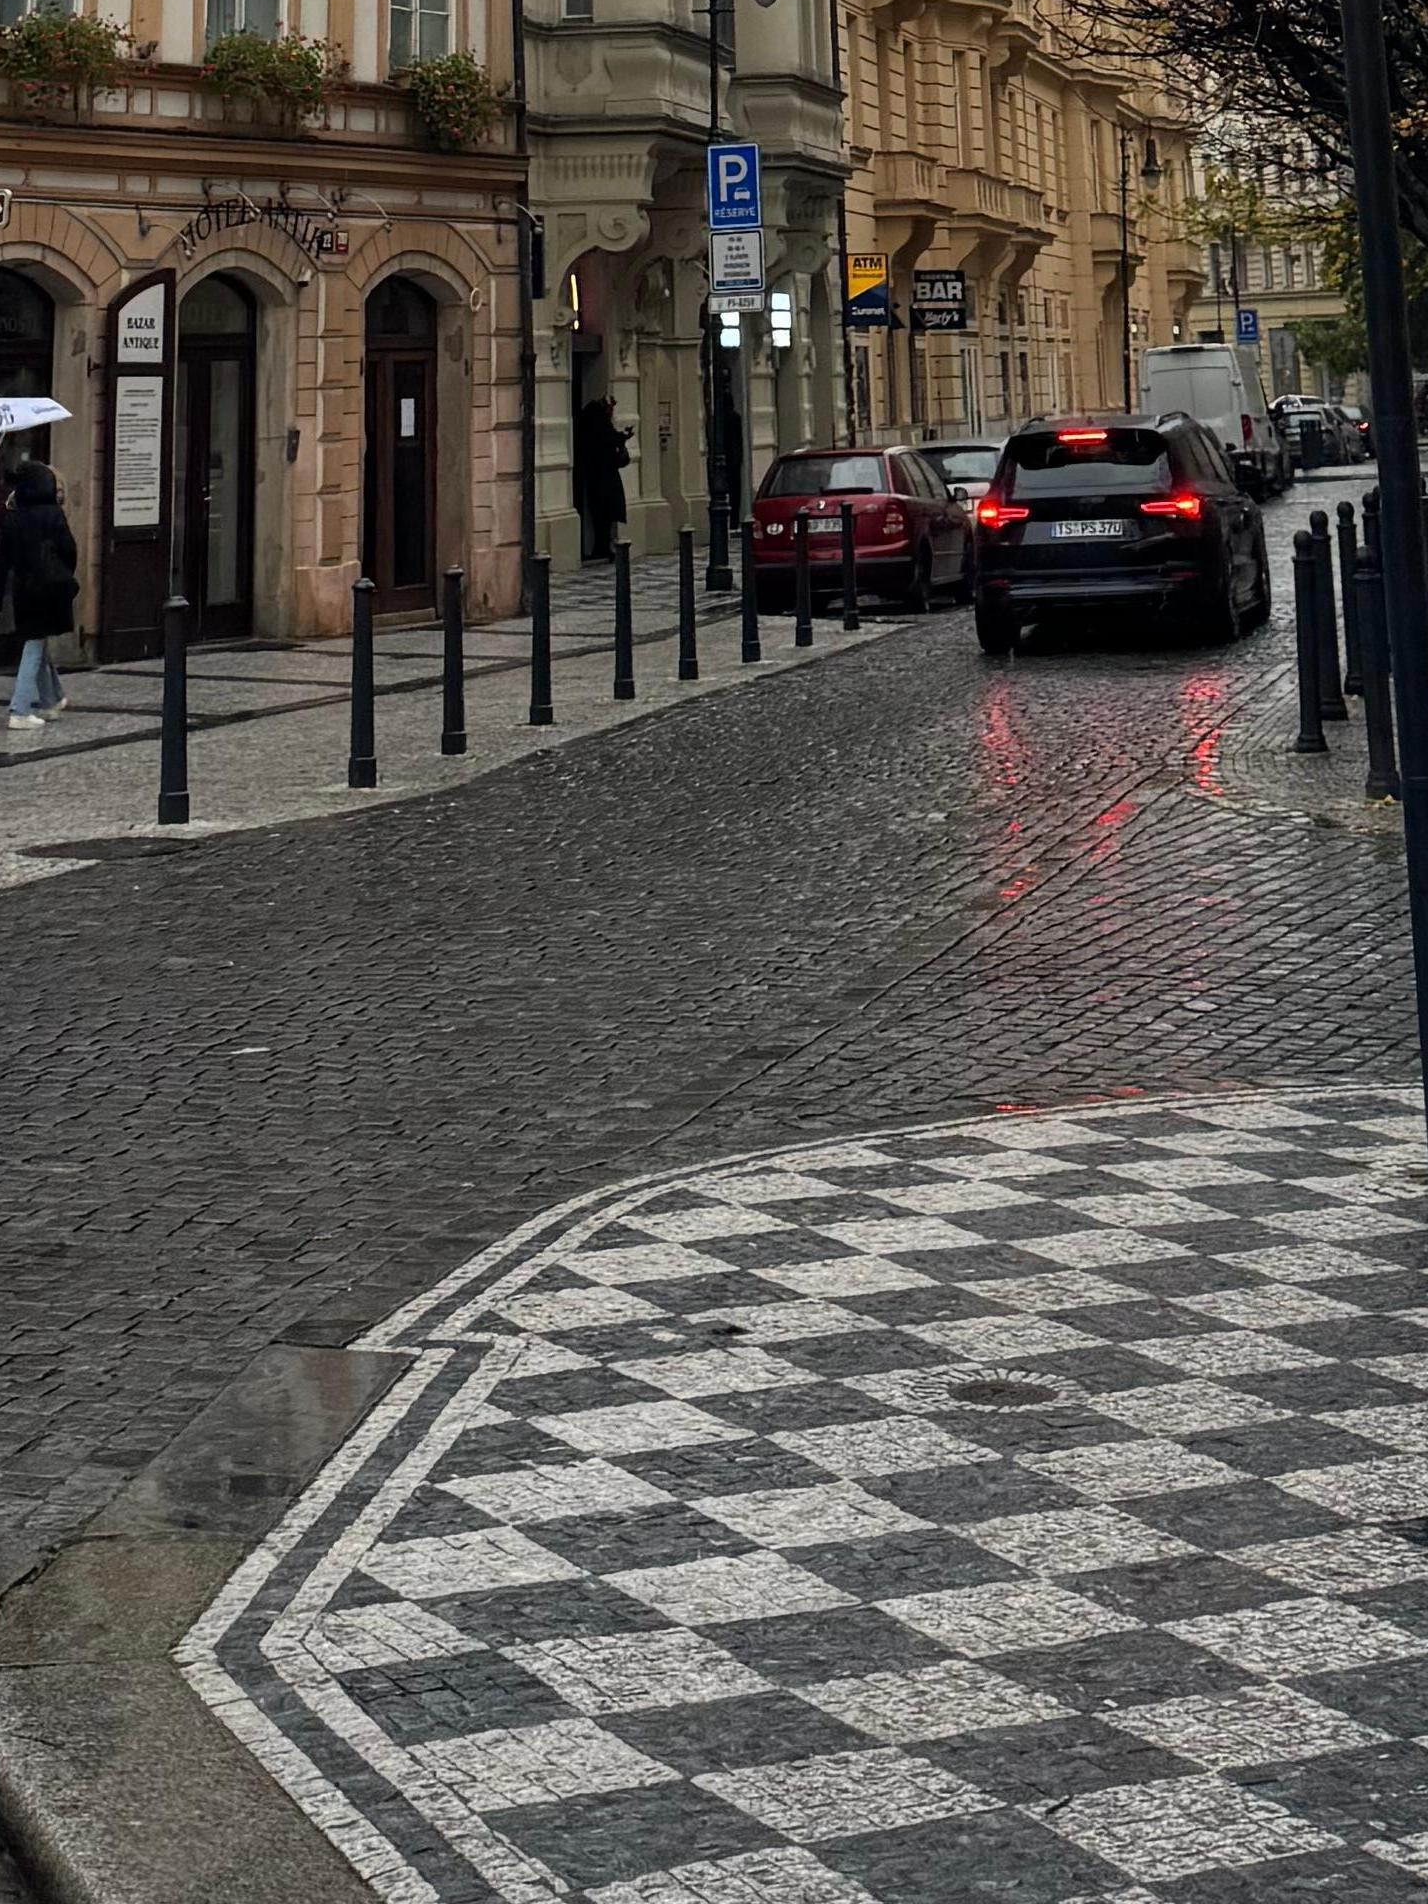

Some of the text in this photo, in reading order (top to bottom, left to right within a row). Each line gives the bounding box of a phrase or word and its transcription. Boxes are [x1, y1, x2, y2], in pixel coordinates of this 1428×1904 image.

[718, 155, 748, 202] P
[179, 197, 257, 253] HOTEL
[853, 257, 882, 269] ATM
[916, 282, 962, 299] BAR
[127, 317, 155, 330] BAZAR
[123, 337, 159, 350] ANTIQUE
